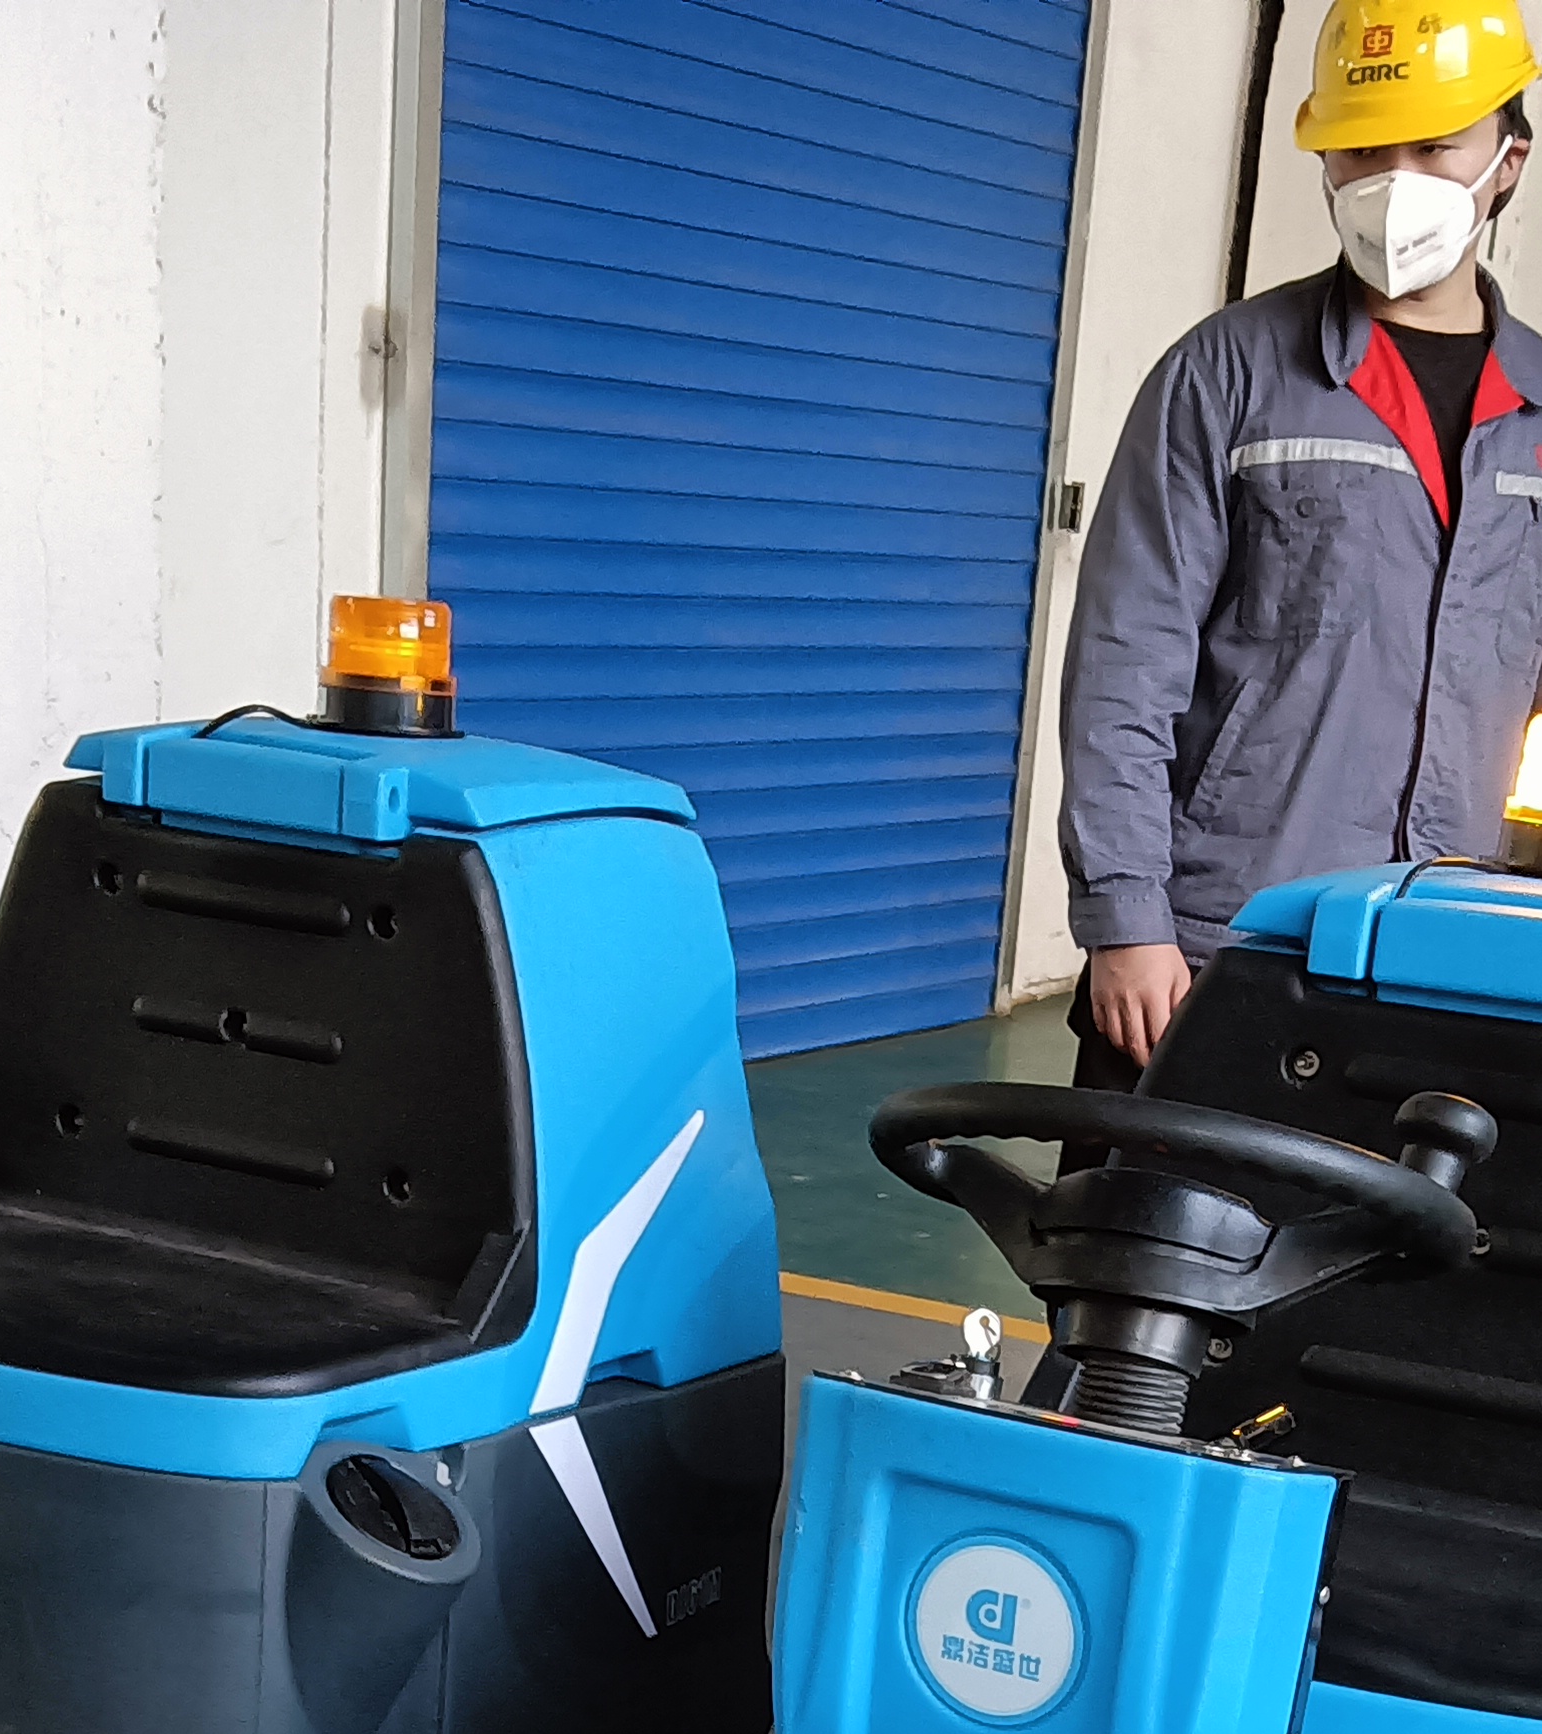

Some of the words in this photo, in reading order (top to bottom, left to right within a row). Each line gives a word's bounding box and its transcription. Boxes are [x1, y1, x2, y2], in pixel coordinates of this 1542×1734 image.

[1346, 61, 1410, 86] CRRC
[941, 1634, 1042, 1683] 鼎洁盛世
